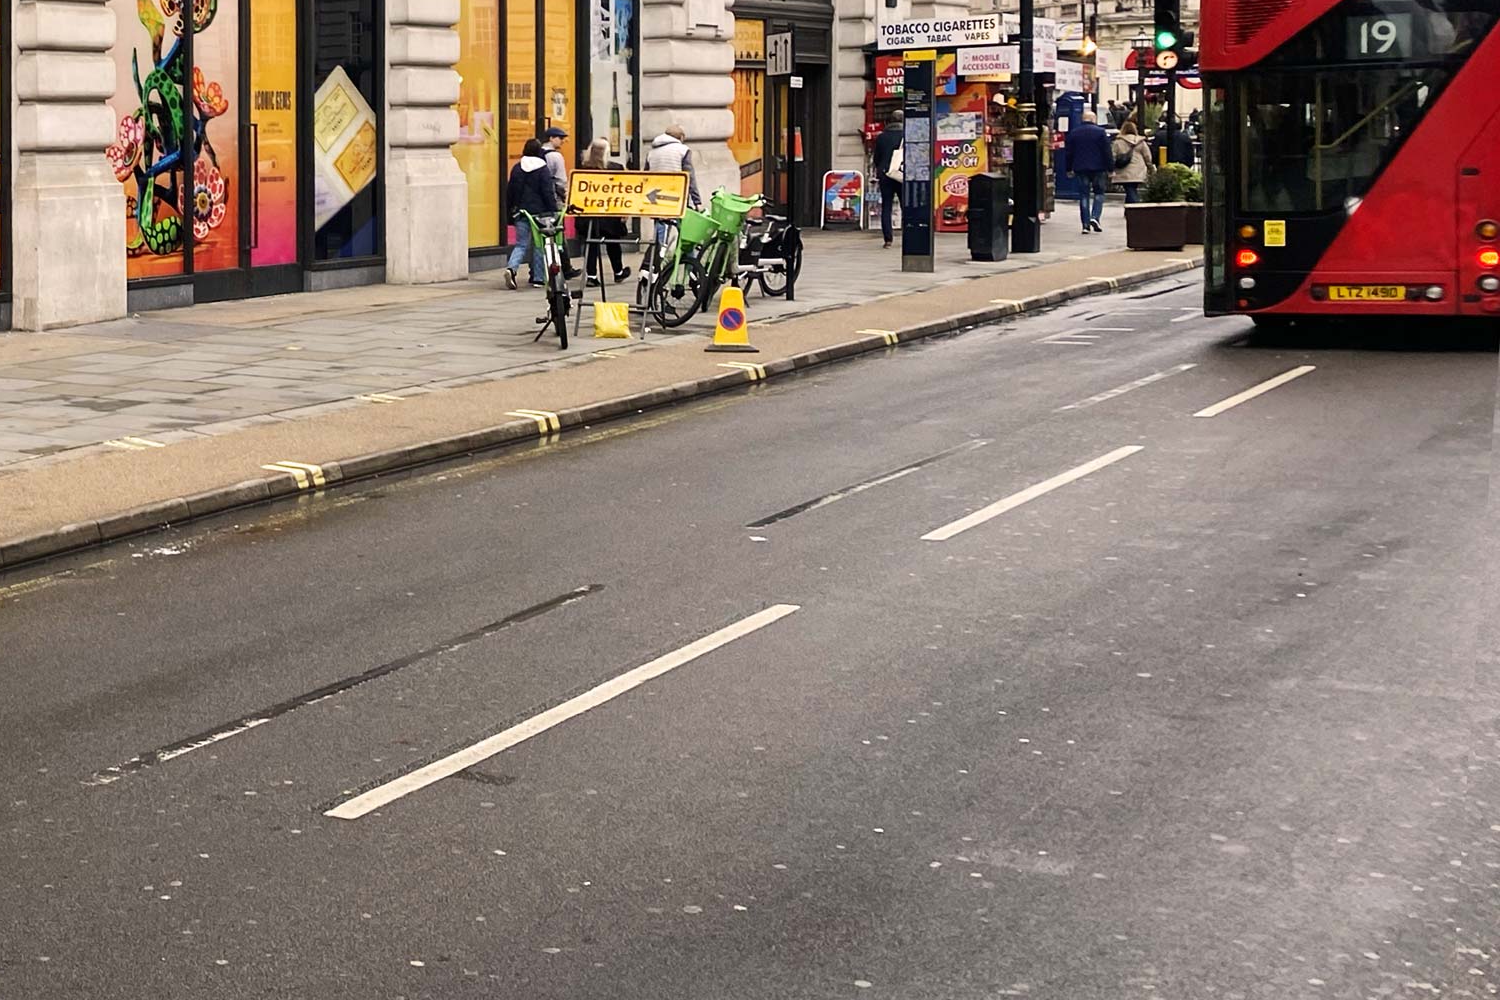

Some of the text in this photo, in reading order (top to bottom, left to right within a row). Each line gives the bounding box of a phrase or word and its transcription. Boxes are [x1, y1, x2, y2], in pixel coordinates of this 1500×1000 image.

[881, 22, 930, 36] TOBACCO
[933, 18, 996, 33] CIGARETTES
[886, 32, 990, 45] CIGARS TABAC VAPES
[1360, 20, 1397, 53] 19
[971, 54, 1000, 62] MOBILE
[886, 68, 905, 77] BUY
[962, 62, 1011, 71] ACCESSORIES
[941, 143, 977, 156] Hop On
[941, 156, 979, 168] Hop Off
[578, 180, 644, 194] Diverted
[583, 196, 632, 208] traffic
[1336, 287, 1364, 298] LTZ
